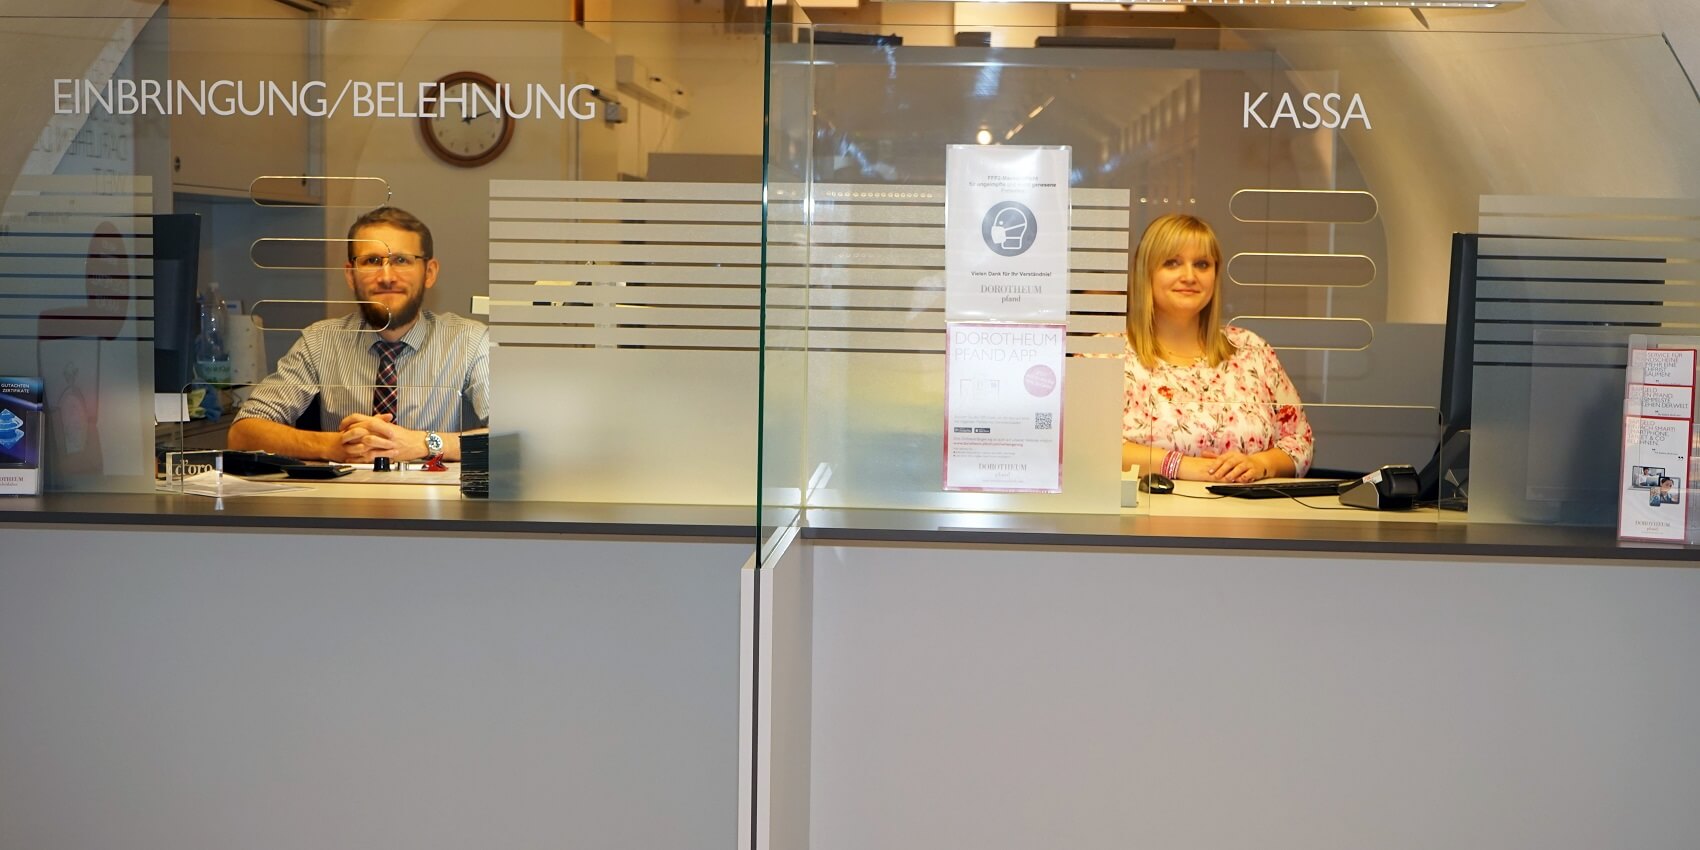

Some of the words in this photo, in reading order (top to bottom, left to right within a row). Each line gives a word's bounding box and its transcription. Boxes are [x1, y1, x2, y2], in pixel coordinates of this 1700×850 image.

[53, 77, 597, 121] EINBRINGUNG/BELEHNUNG
[1243, 91, 1372, 129] KASSA
[981, 284, 1042, 294] DOROTHEUM
[1001, 295, 1021, 303] pfand
[955, 331, 1057, 347] DOROTHEUM
[955, 348, 1005, 362] PFAND
[1008, 349, 1037, 362] APP
